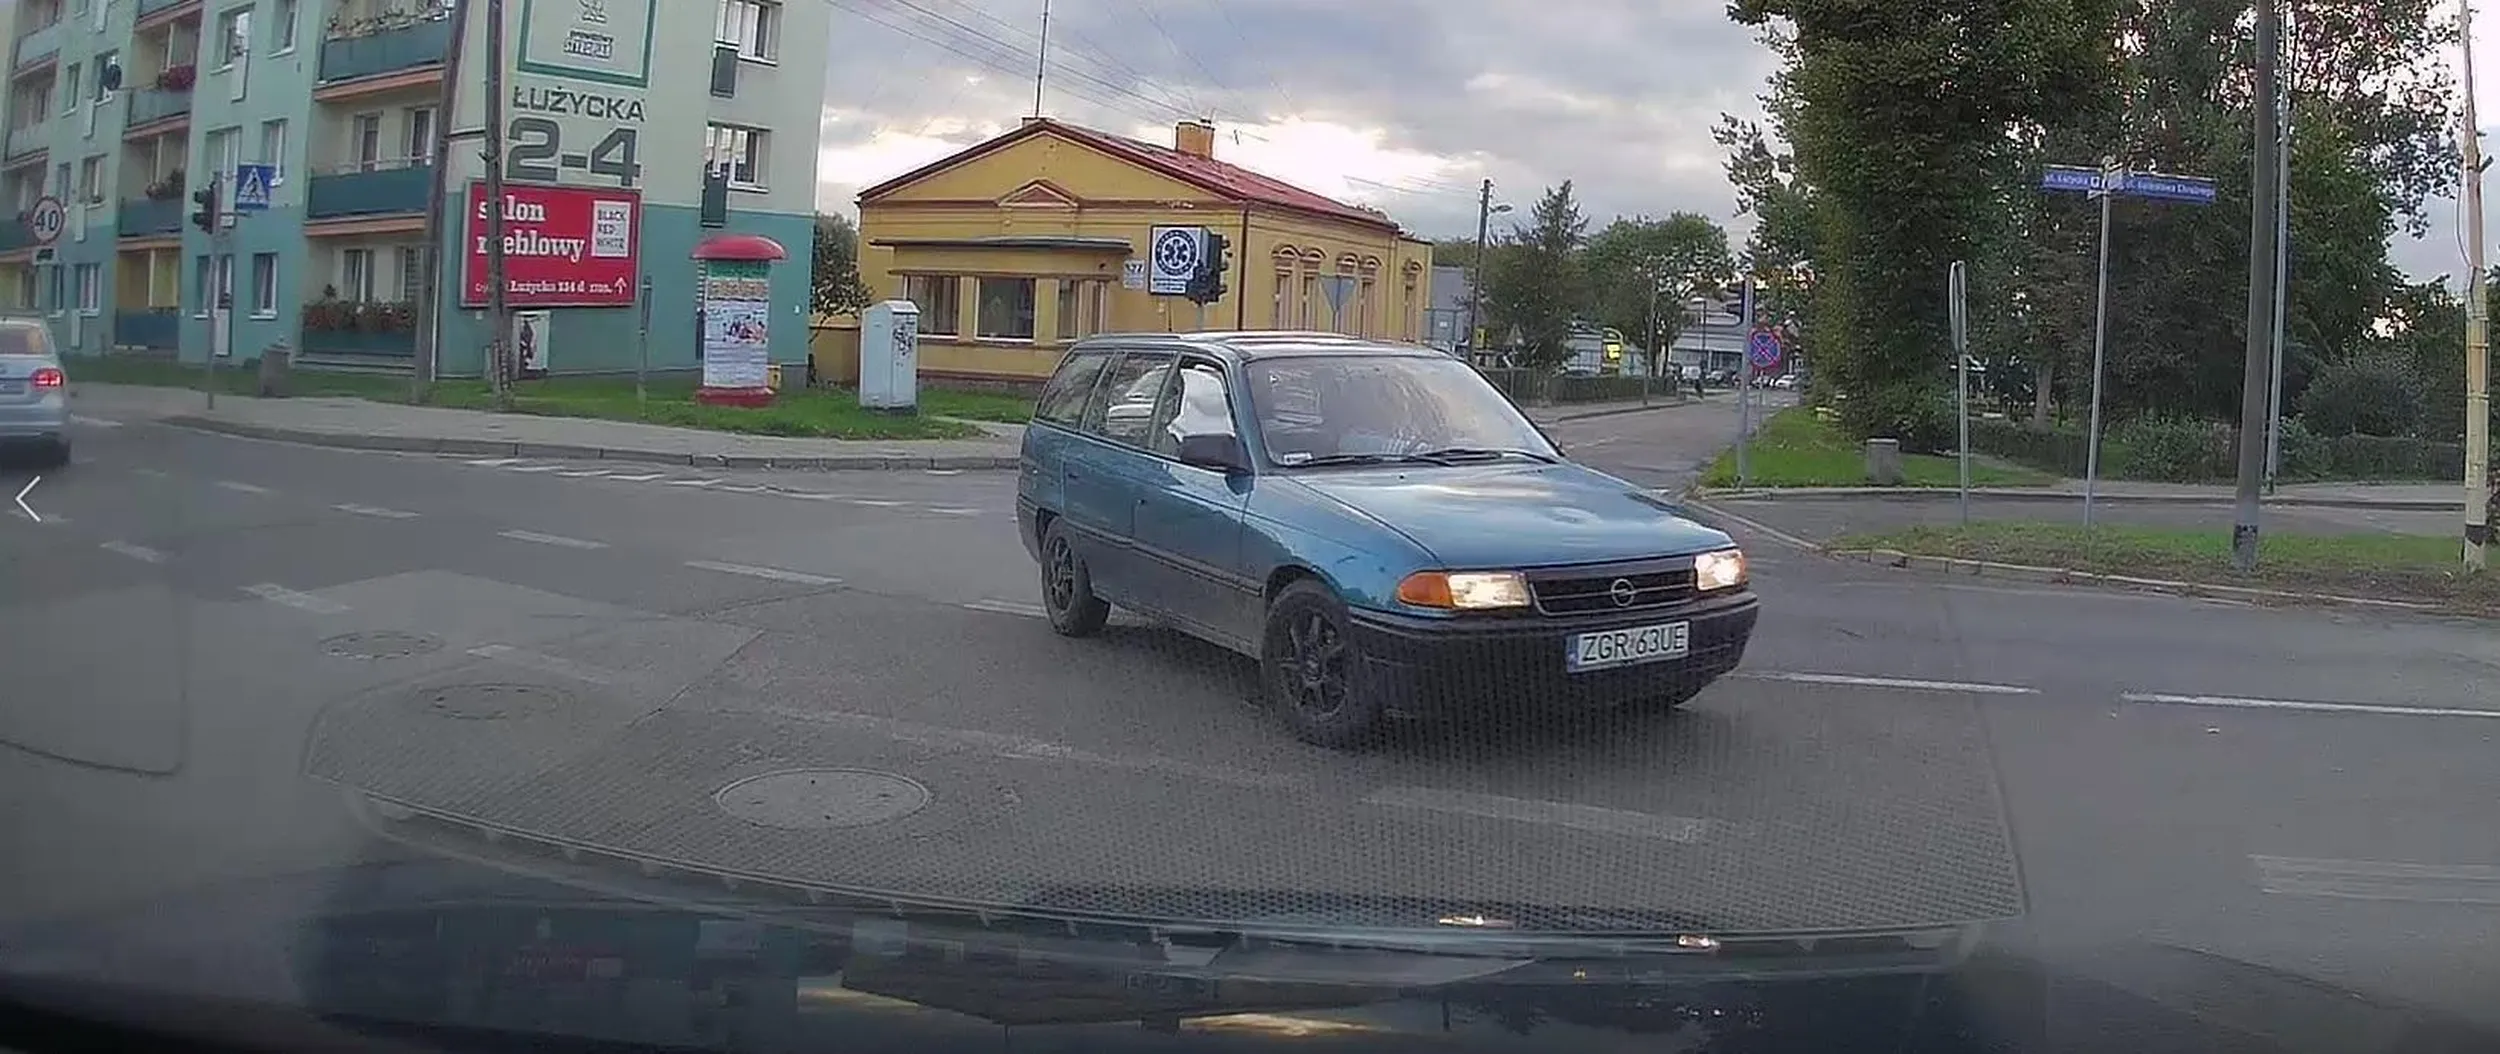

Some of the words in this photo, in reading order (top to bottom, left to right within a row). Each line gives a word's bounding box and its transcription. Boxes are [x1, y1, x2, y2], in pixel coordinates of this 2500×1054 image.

[512, 85, 645, 122] ŁUŻYCKA
[506, 117, 641, 187] 2-4
[34, 209, 59, 232] 40
[477, 194, 546, 222] slon
[1582, 632, 1629, 661] ZGR
[1635, 624, 1686, 655] 63UE
